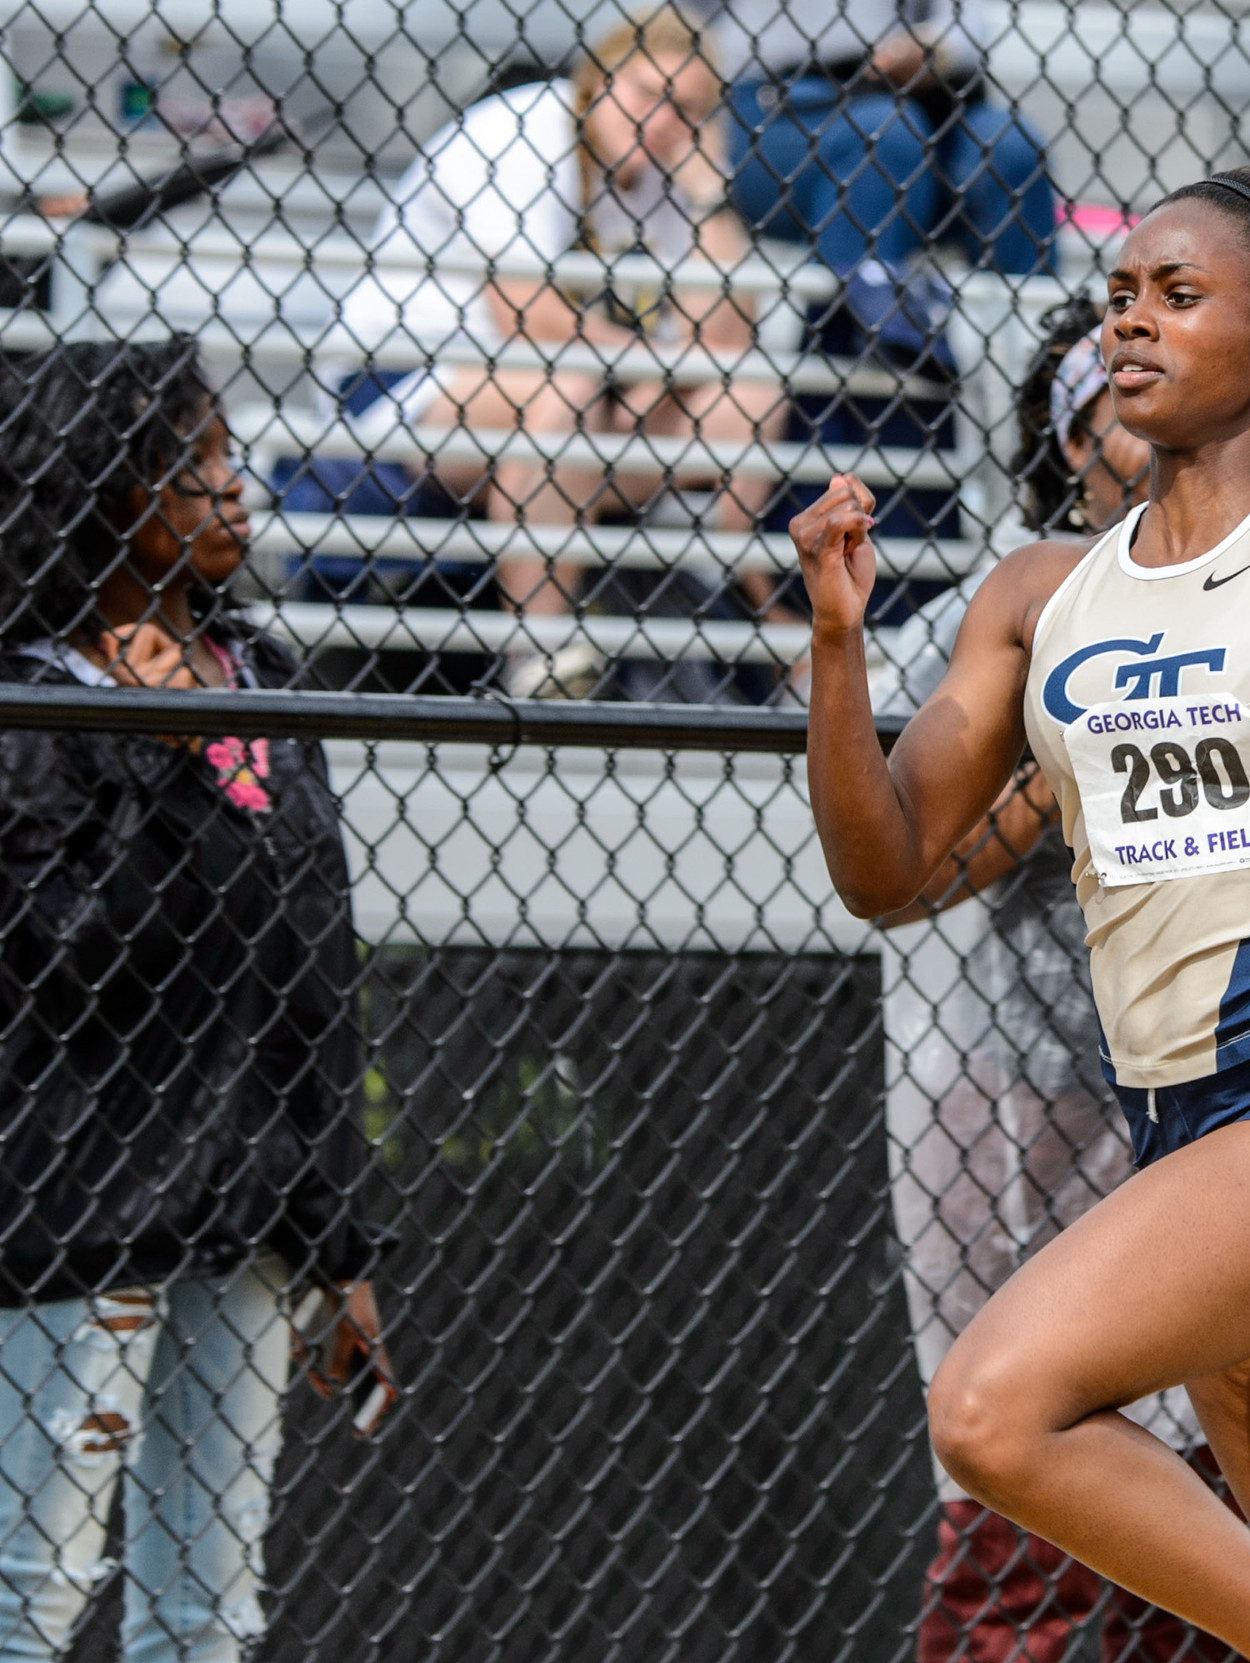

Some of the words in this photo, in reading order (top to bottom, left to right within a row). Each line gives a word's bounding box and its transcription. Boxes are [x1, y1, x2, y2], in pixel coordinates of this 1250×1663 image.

[1086, 709, 1182, 735] GEORGIA
[1186, 703, 1242, 726] TECH
[1110, 736, 1250, 824] 290
[1115, 839, 1178, 866] TRACK
[1184, 836, 1200, 857] &
